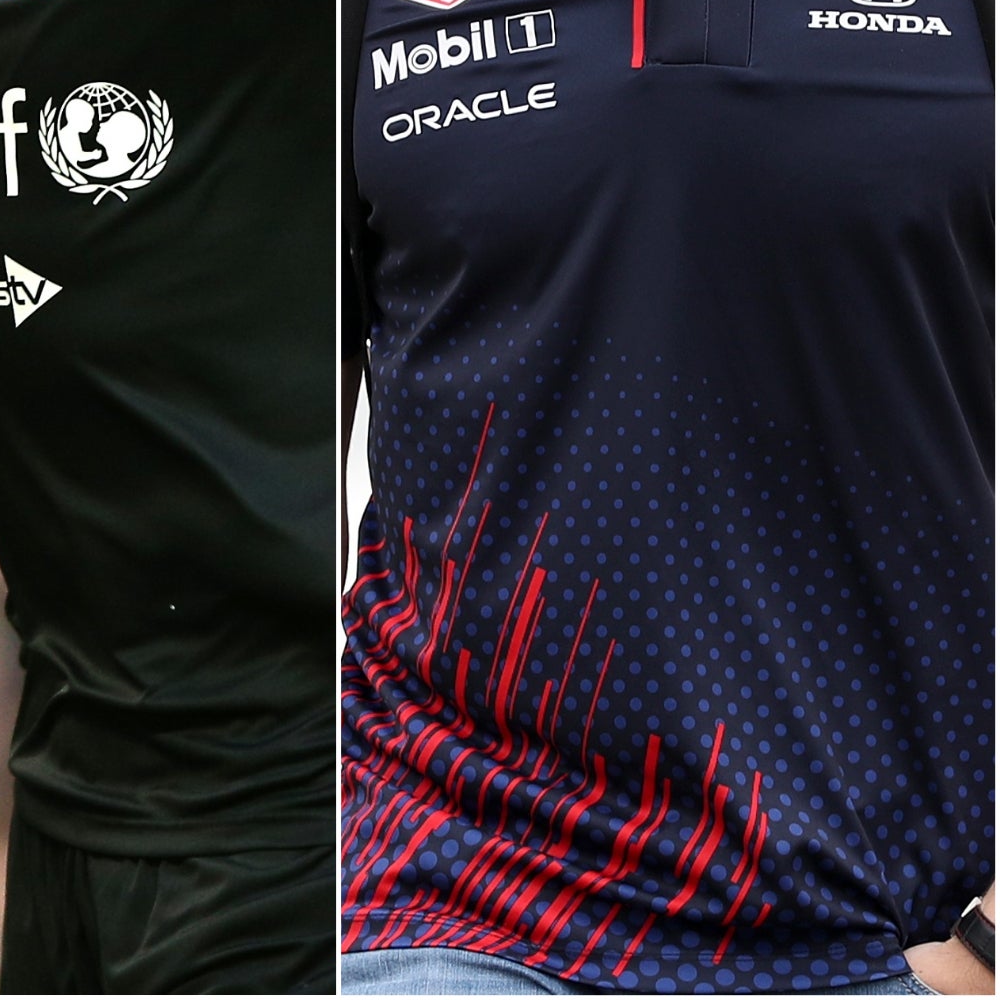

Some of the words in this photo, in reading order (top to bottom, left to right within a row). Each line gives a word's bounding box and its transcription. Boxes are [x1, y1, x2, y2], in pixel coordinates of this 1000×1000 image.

[371, 18, 498, 90] Mobil
[519, 15, 537, 48] 1
[808, 10, 952, 36] HONDA
[382, 82, 557, 142] ORACLE
